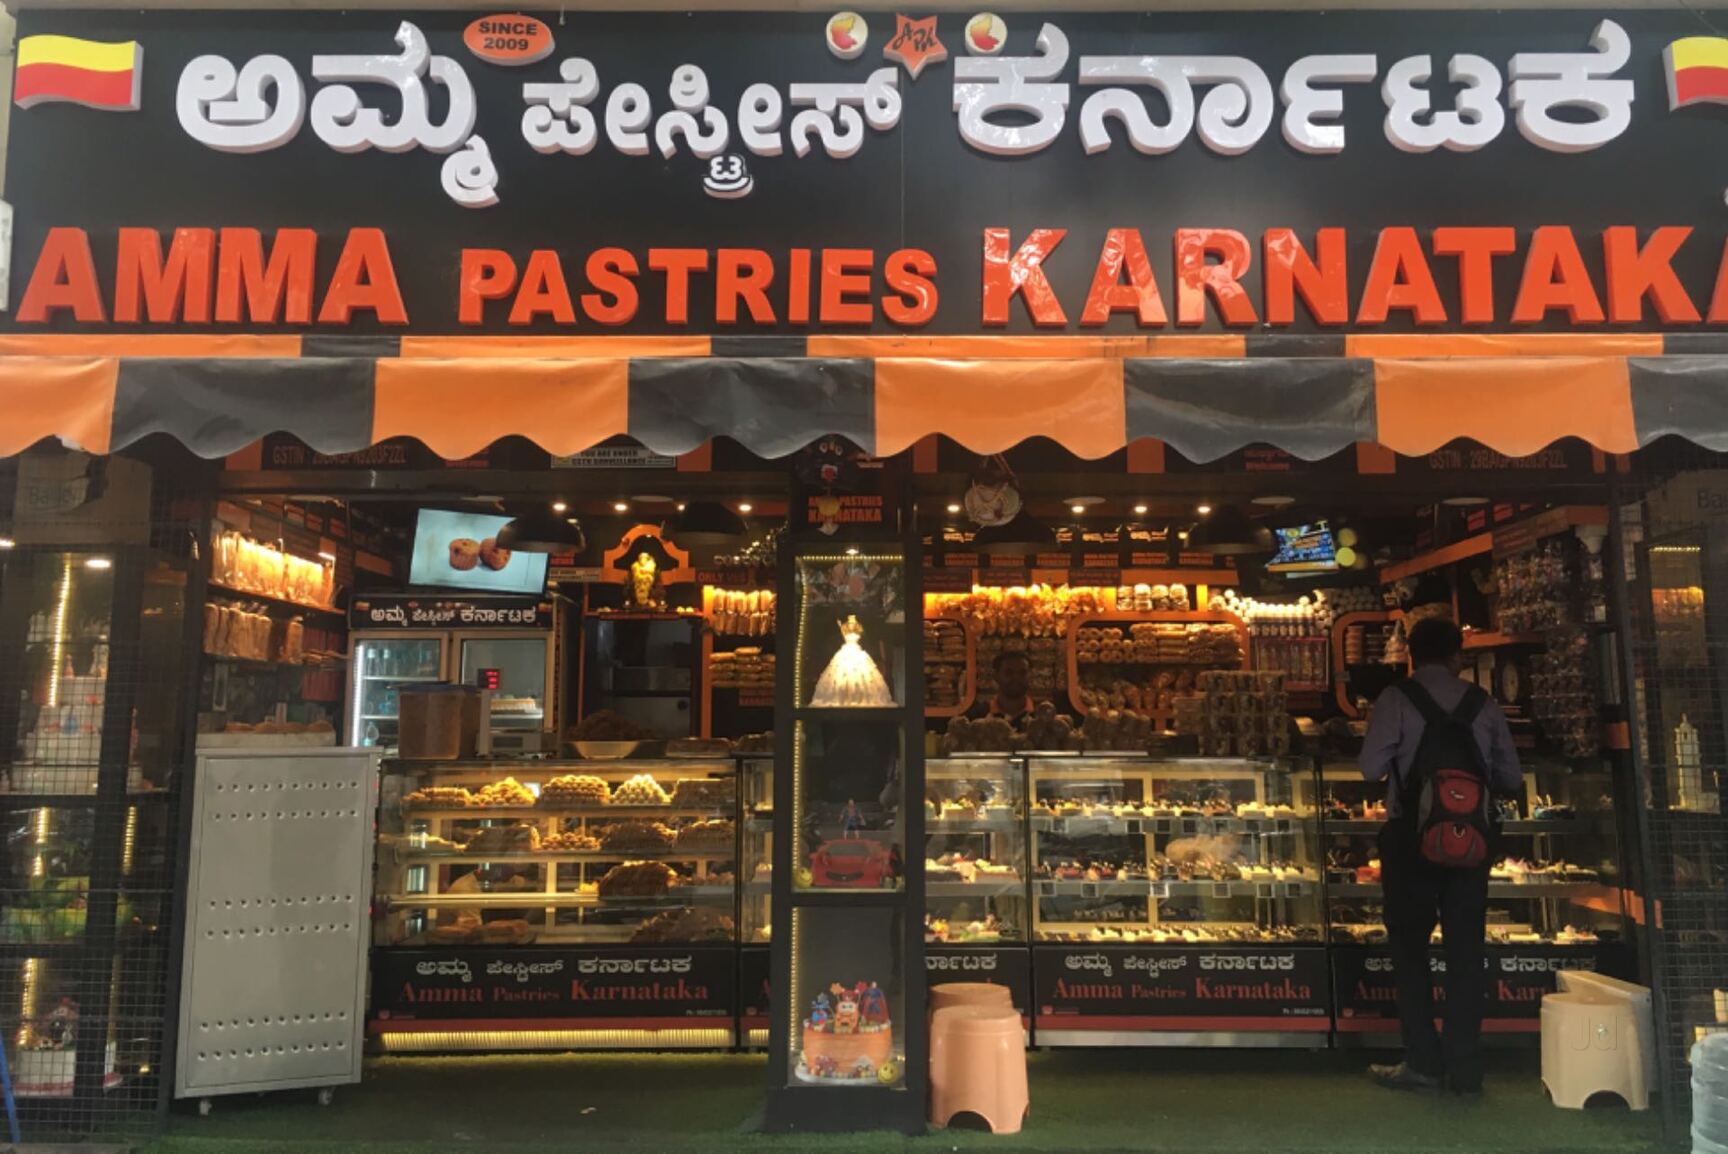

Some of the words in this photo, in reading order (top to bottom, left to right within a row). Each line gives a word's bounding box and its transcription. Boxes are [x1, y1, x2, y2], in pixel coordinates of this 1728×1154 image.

[478, 21, 537, 36] SINCE
[483, 37, 529, 51] 2009
[176, 20, 500, 207] ಅಮ್ಮ
[953, 18, 1634, 155] ಕರ್ನಾಟಕ
[15, 227, 409, 325] AMMA
[458, 247, 939, 327] PASTRIES
[982, 225, 1728, 326] KARNATAK
[400, 980, 483, 1002] Amma
[571, 978, 708, 1001] Karnataka
[1053, 976, 1123, 999] Amma
[1195, 976, 1311, 999] Karnataka
